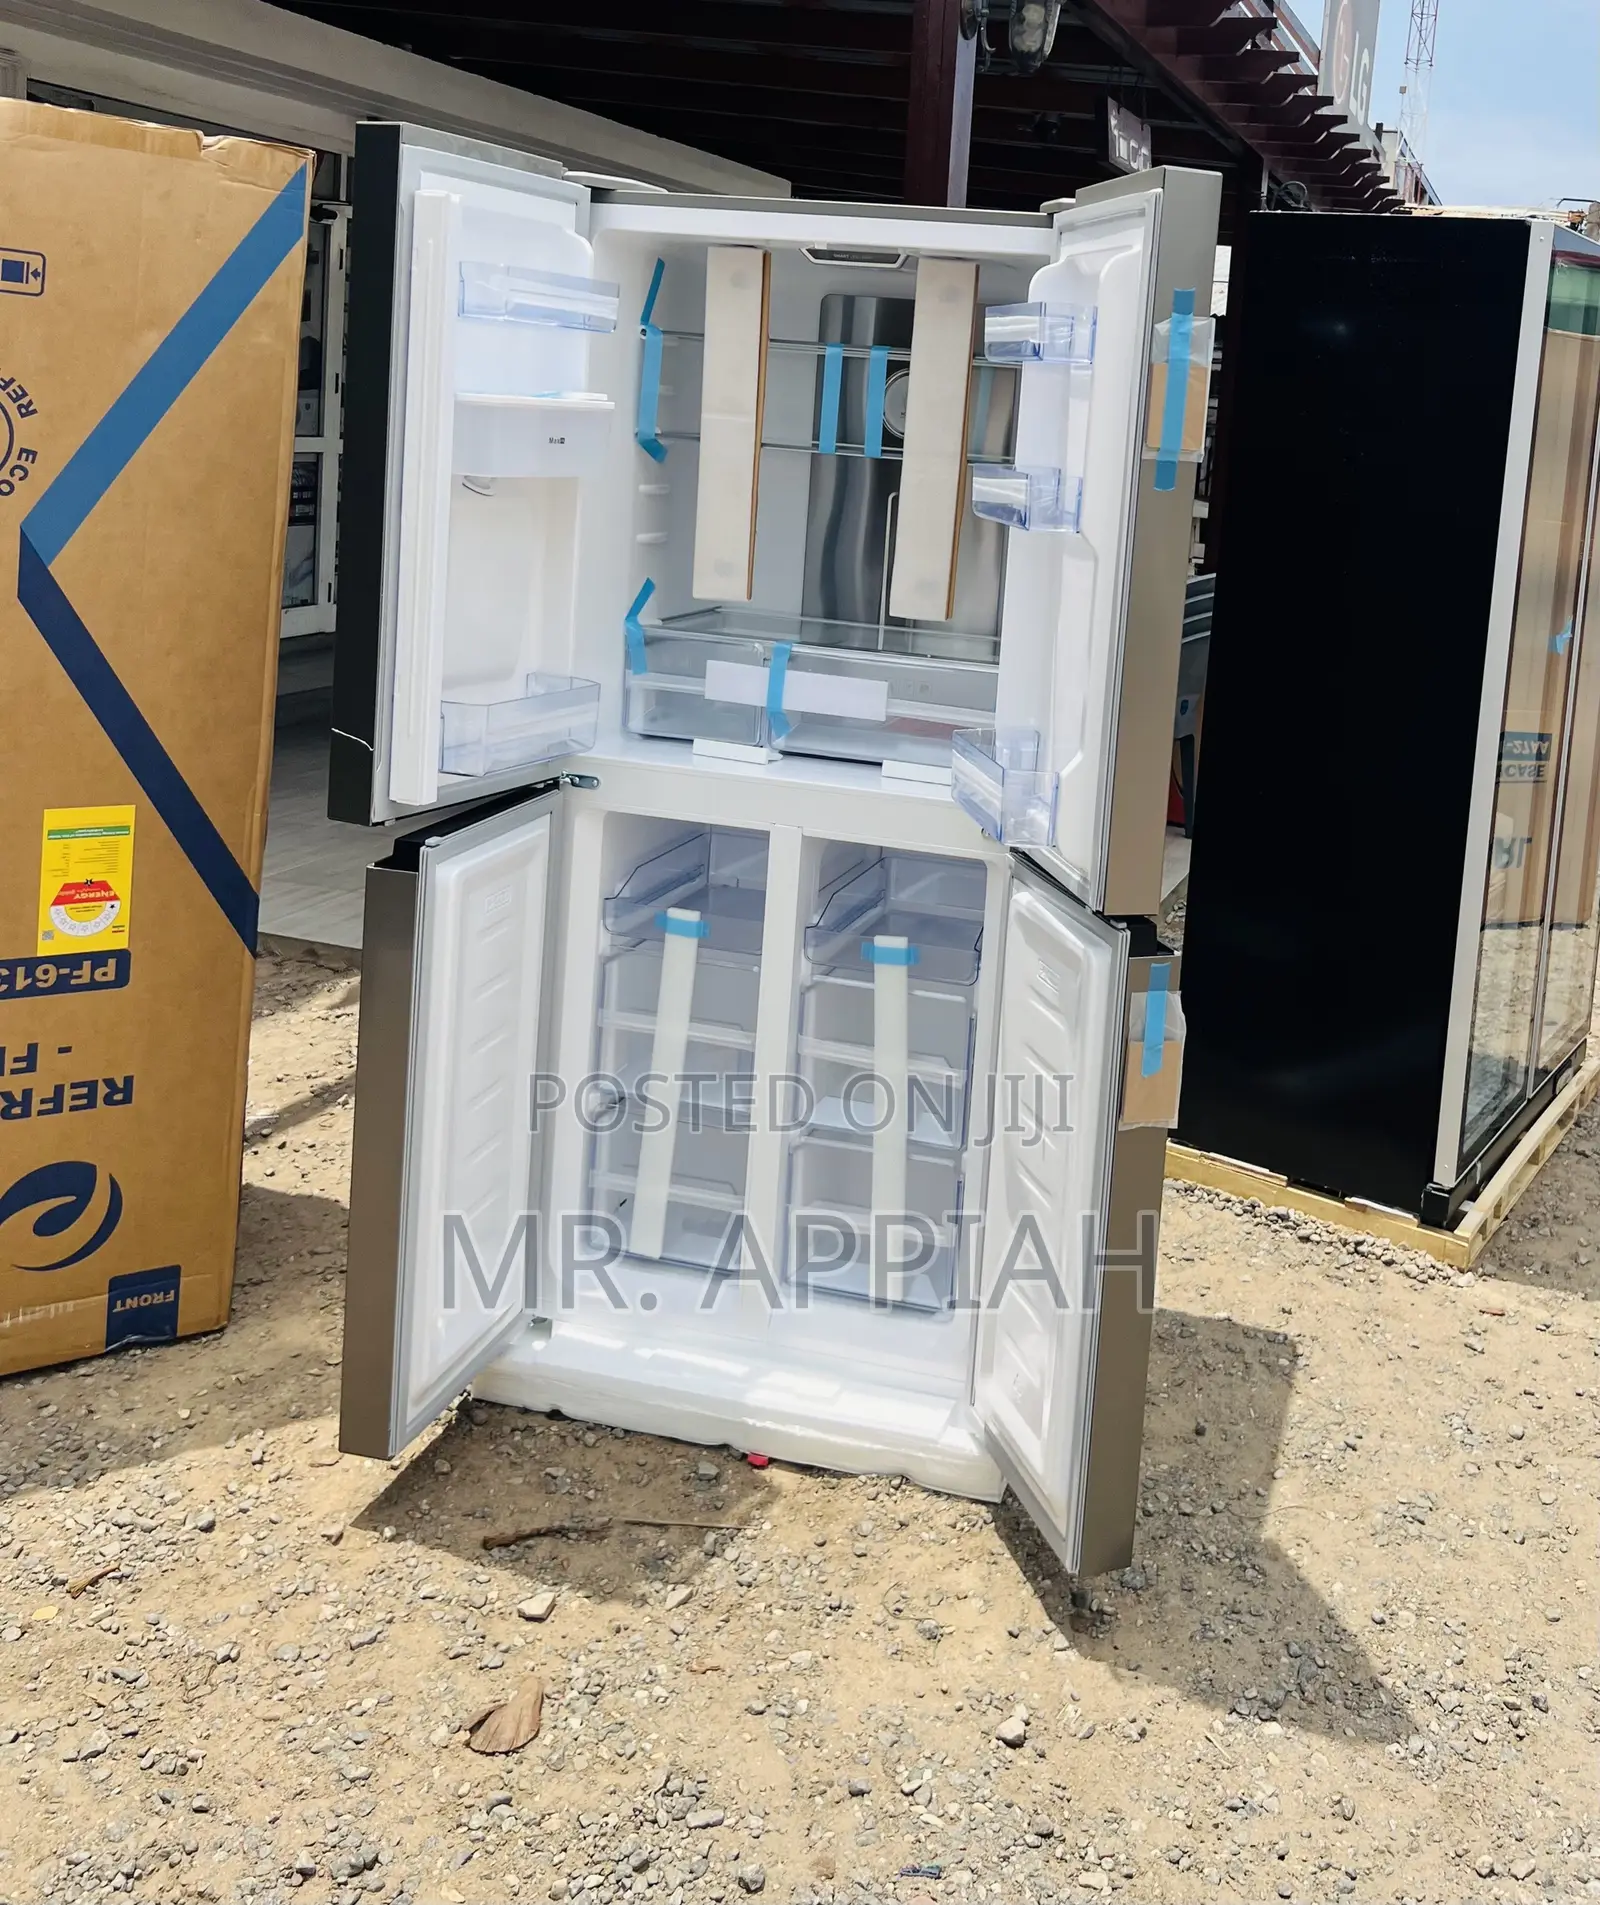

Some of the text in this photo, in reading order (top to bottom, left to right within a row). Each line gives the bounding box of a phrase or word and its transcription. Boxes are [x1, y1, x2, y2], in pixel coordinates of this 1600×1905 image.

[1348, 30, 1370, 126] LG
[0, 447, 39, 497] ECO
[73, 888, 115, 900] ENERGY
[0, 1042, 39, 1077] F
[112, 1289, 175, 1313] FRONT
